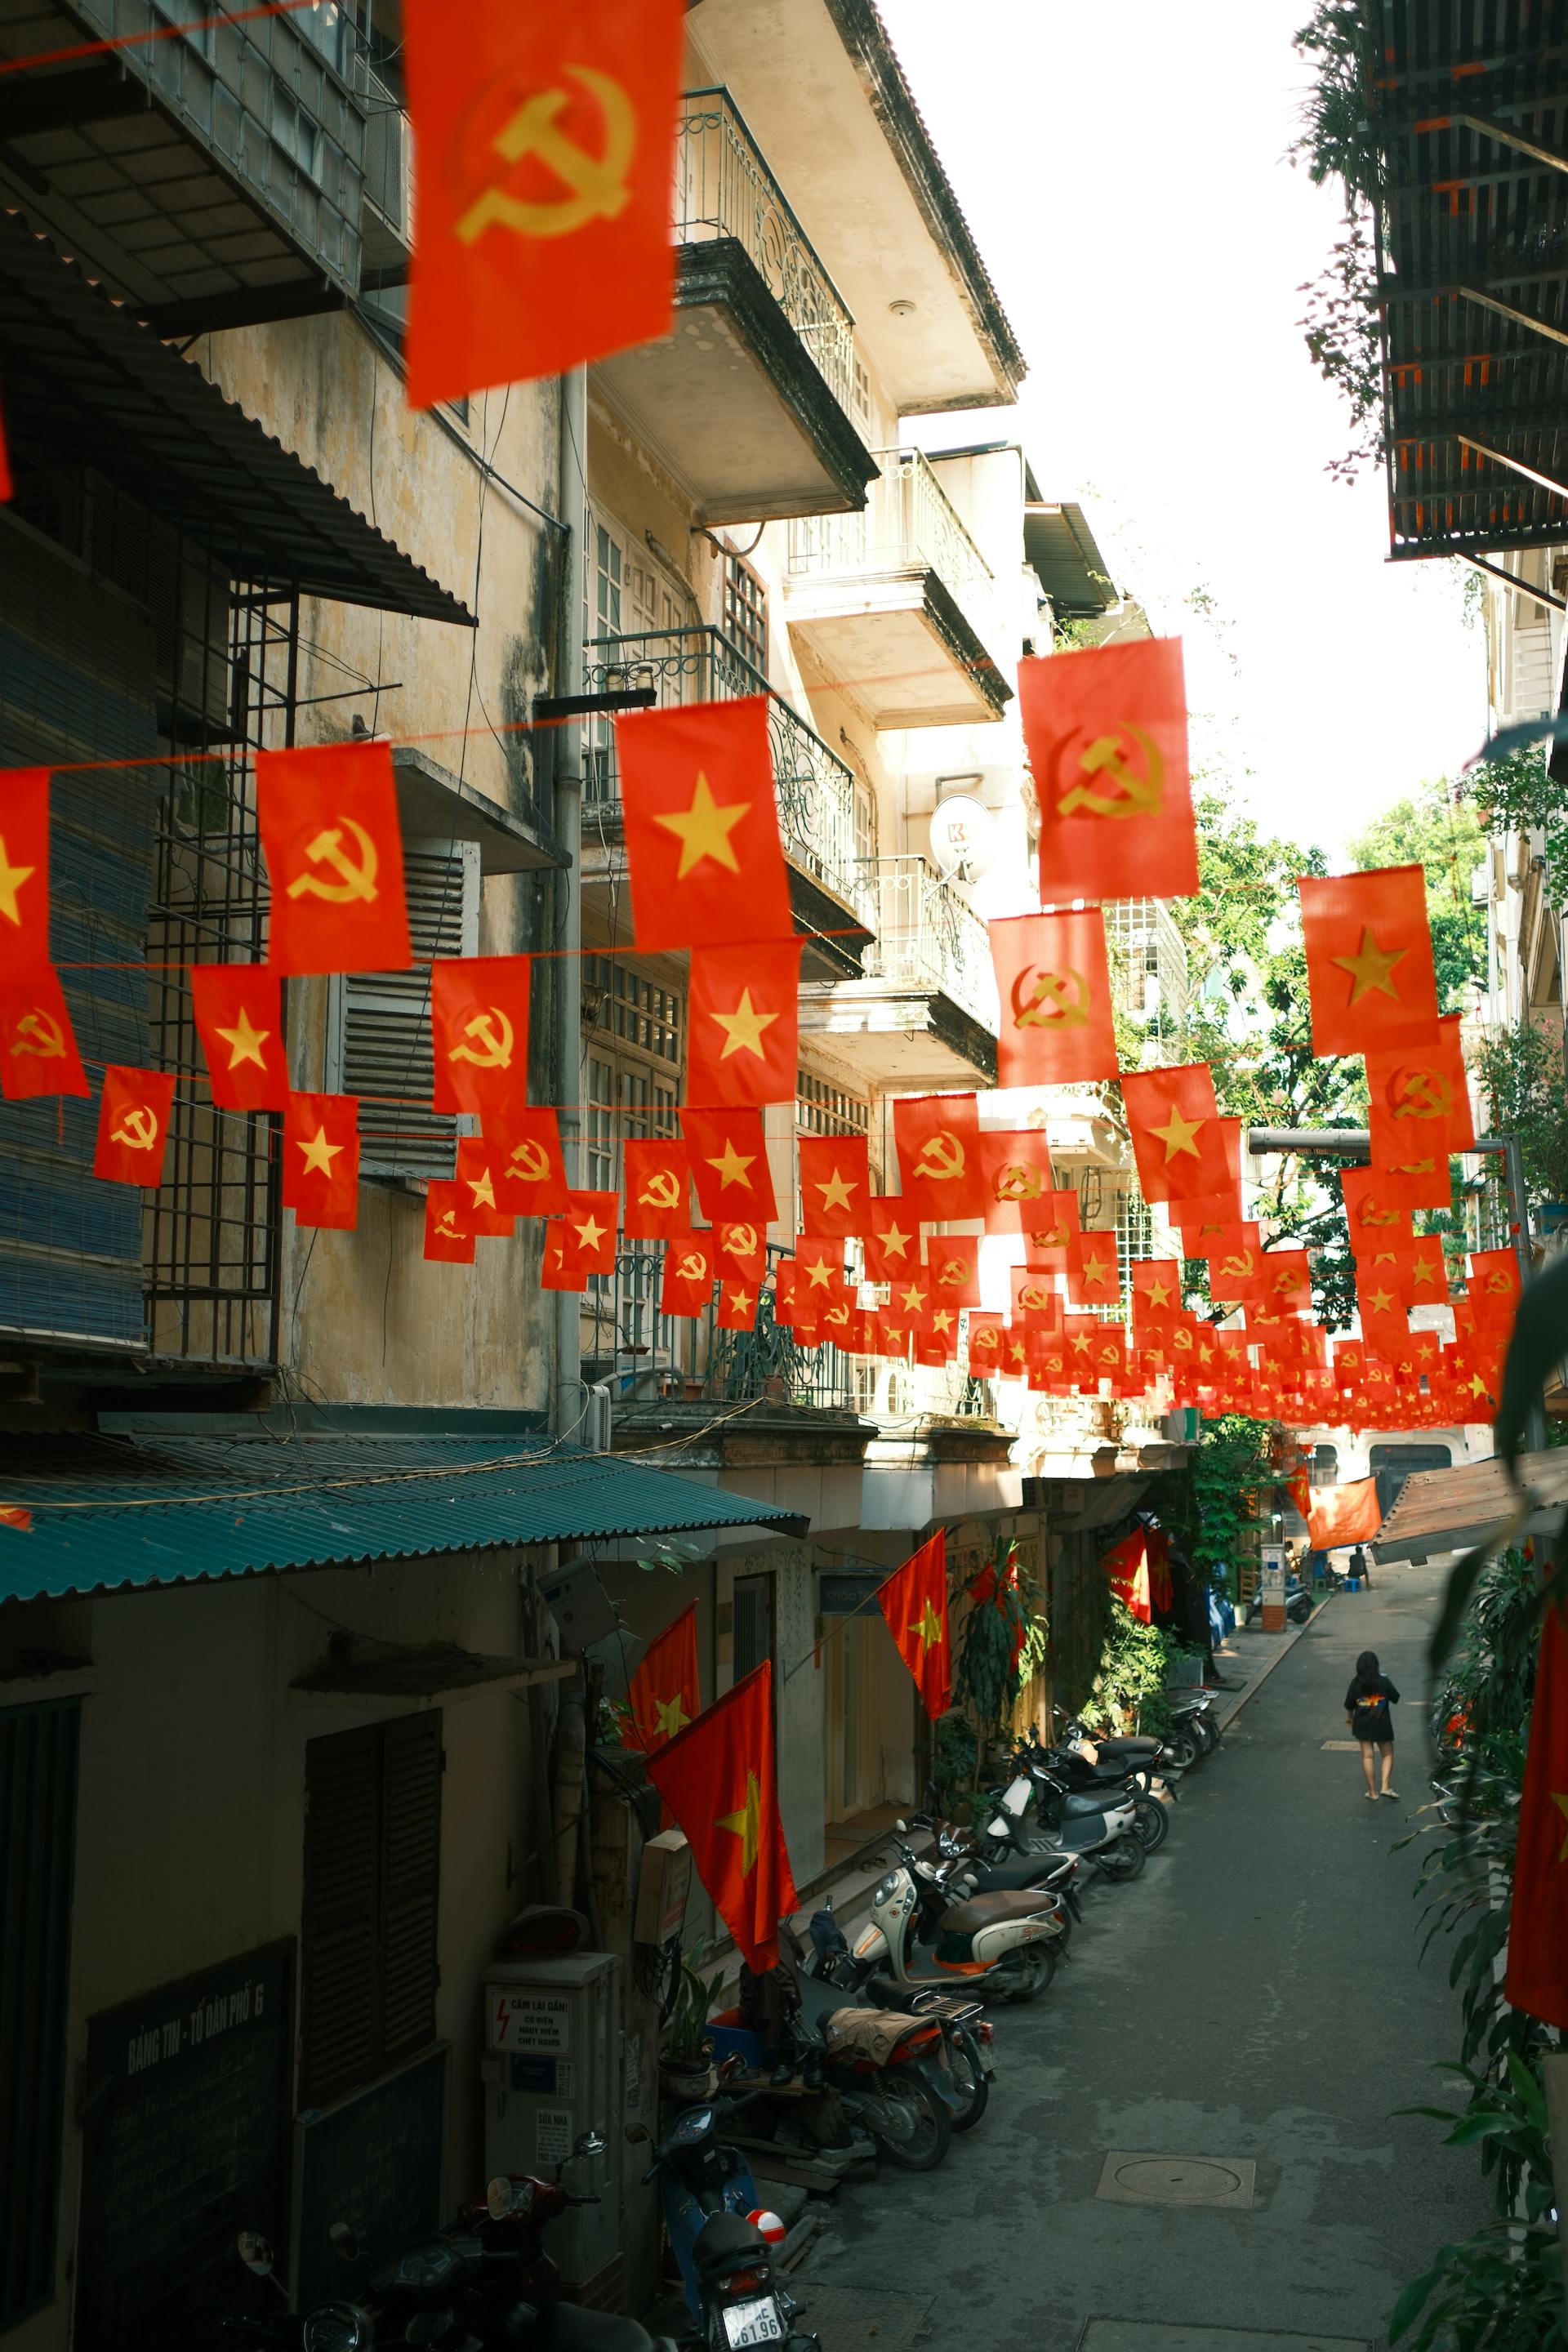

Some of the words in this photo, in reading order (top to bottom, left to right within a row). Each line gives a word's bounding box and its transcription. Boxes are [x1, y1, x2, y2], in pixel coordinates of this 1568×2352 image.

[510, 1997, 530, 2010] CẤM
[532, 2001, 546, 2012] LẠI
[127, 2024, 160, 2077] BẢNG
[163, 2019, 181, 2059] TIN
[229, 1980, 252, 2028] PHỐ
[519, 2026, 539, 2034] NGUY
